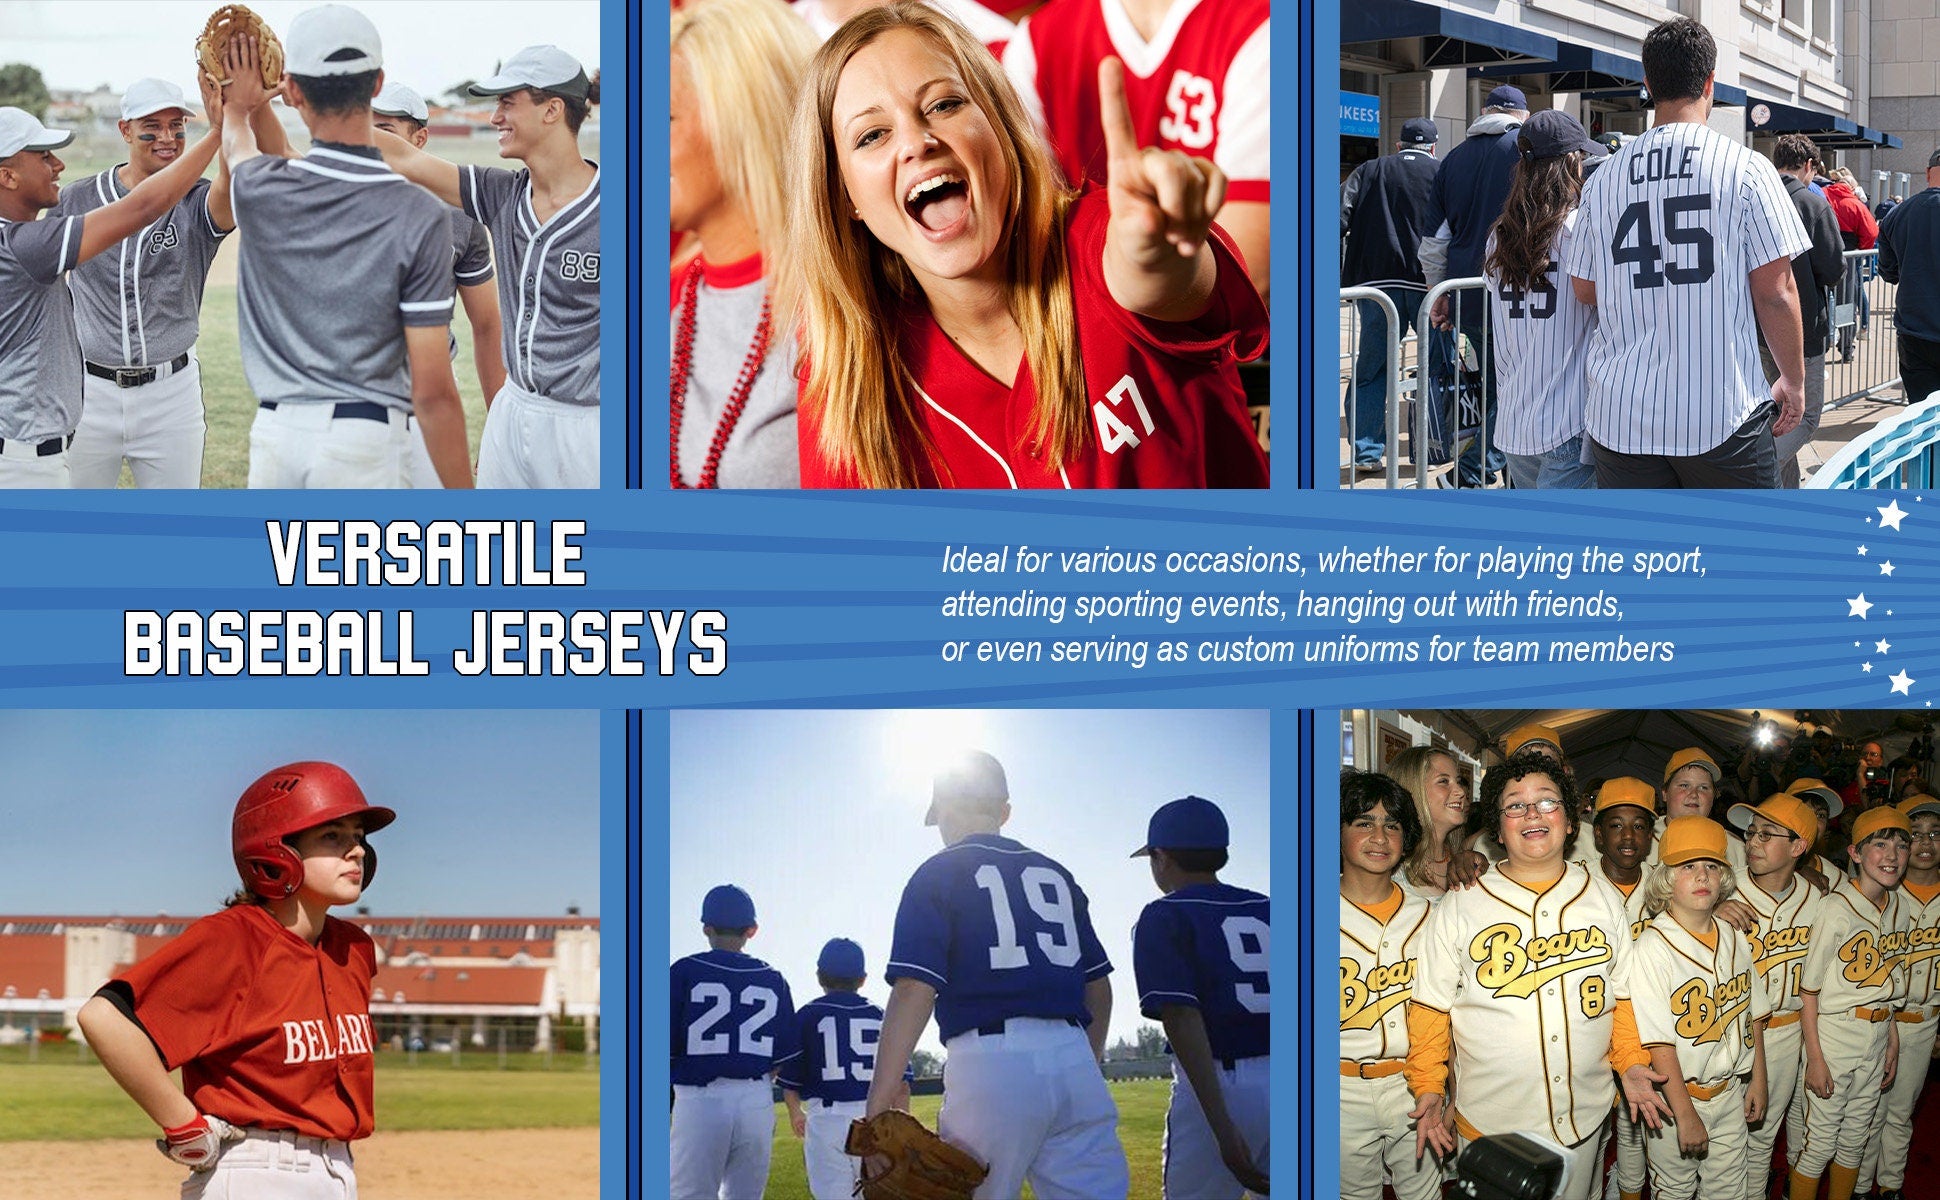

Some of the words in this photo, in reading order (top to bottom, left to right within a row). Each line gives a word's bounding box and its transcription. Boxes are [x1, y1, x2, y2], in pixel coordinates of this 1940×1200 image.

[1160, 68, 1217, 149] 53
[1630, 146, 1700, 185] COLE
[559, 248, 601, 283] 89
[1611, 193, 1715, 289] 45
[1093, 374, 1155, 454] 47
[974, 865, 1082, 969] 19
[1747, 921, 1812, 977] Bear
[1340, 957, 1417, 1031] Bear
[1469, 923, 1612, 999] Bears
[1838, 930, 1909, 988] Bear
[687, 982, 778, 1057] 22
[1579, 975, 1606, 1019] 8
